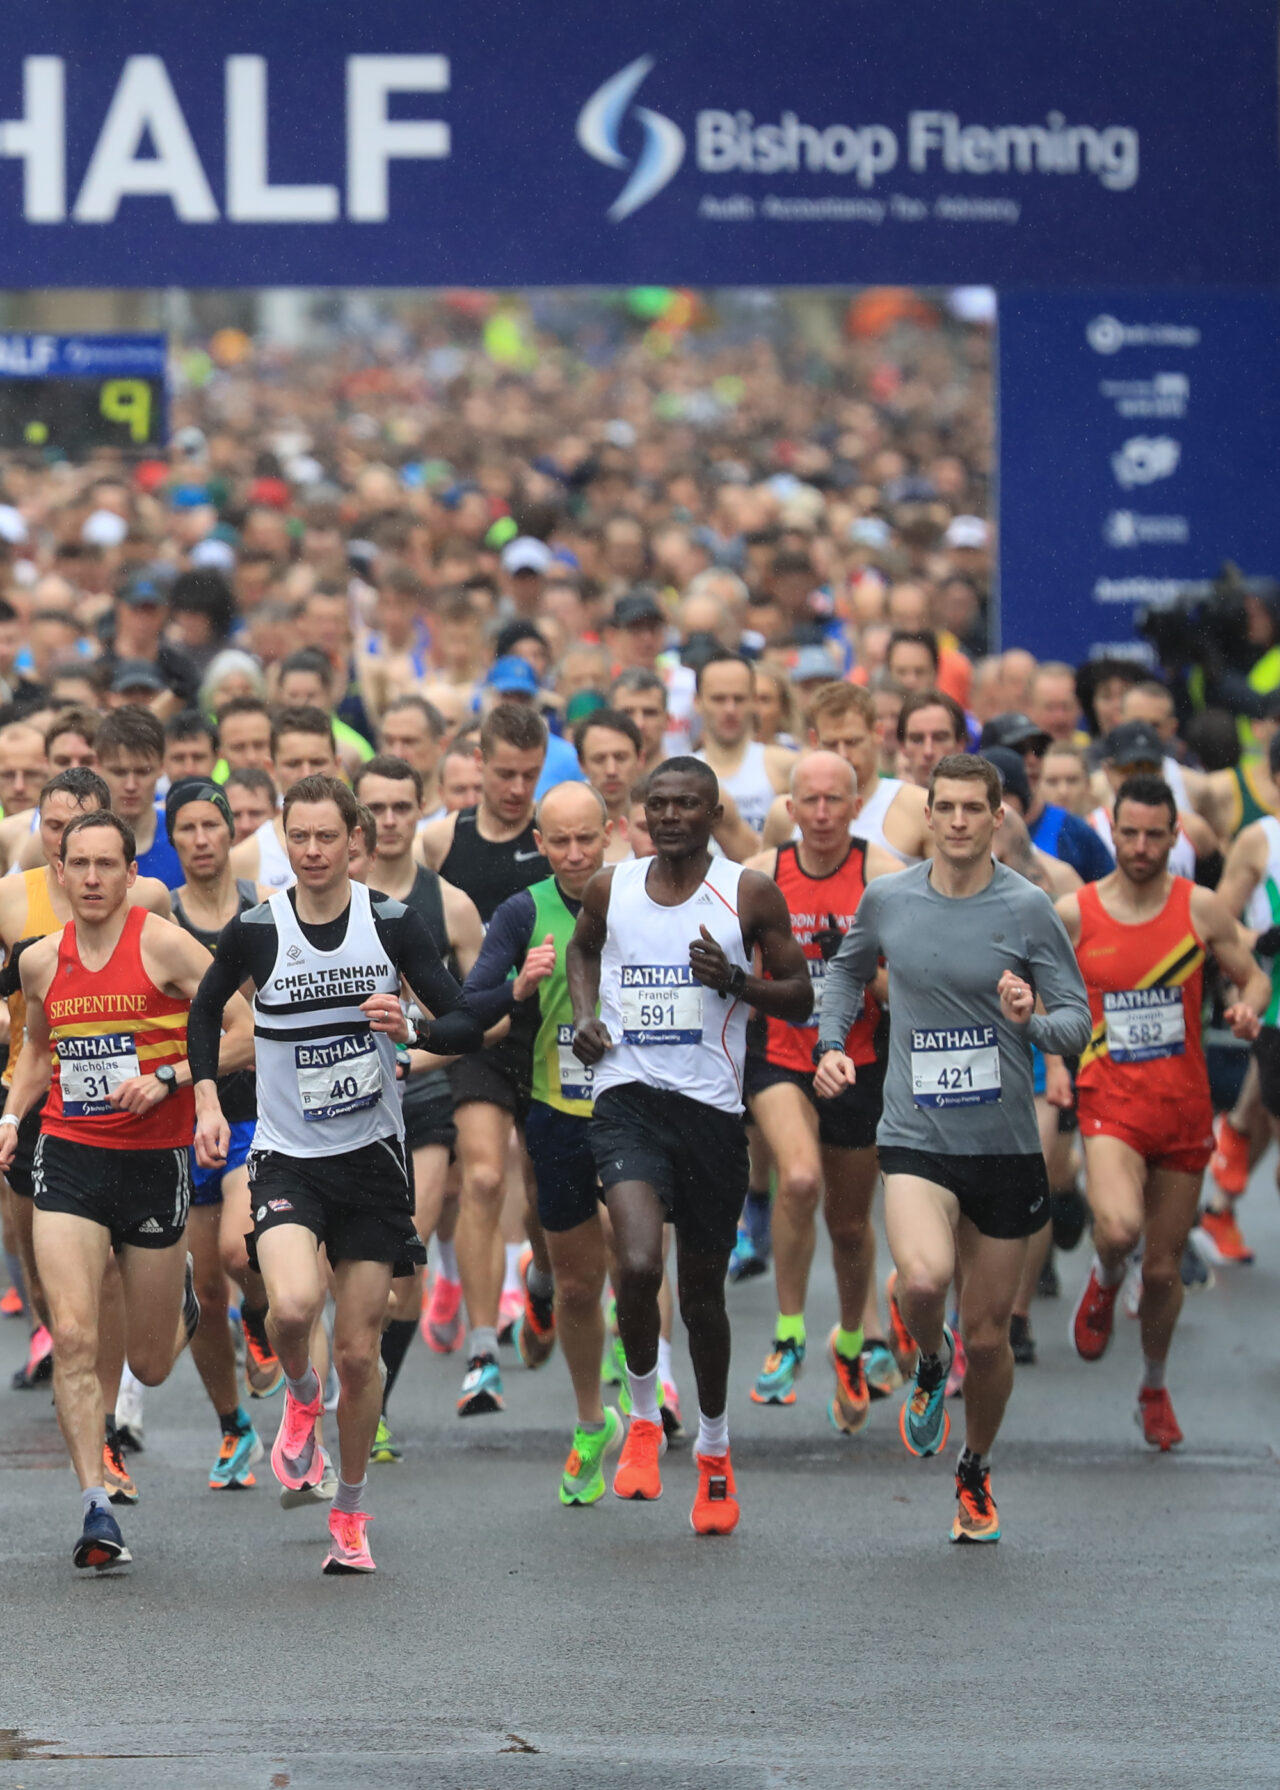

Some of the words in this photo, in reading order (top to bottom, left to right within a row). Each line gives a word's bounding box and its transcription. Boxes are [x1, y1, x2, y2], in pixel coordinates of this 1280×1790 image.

[696, 109, 898, 188] Bishop
[908, 109, 1139, 191] Fleming
[99, 379, 152, 443] 9
[274, 964, 388, 991] CHELTENHAM
[289, 980, 376, 1002] HARRIERS
[1104, 988, 1180, 1010] BATHALF
[50, 995, 147, 1019] SERPENTINE
[640, 1004, 675, 1026] 591
[914, 1027, 994, 1049] BATHALF
[1129, 1023, 1162, 1044] 582
[56, 1036, 133, 1058] BATHALF
[299, 1033, 374, 1066] BATHALF
[72, 1061, 119, 1072] Nicholas
[937, 1066, 973, 1090] 421
[83, 1075, 111, 1098] 31
[330, 1076, 358, 1099] 40
